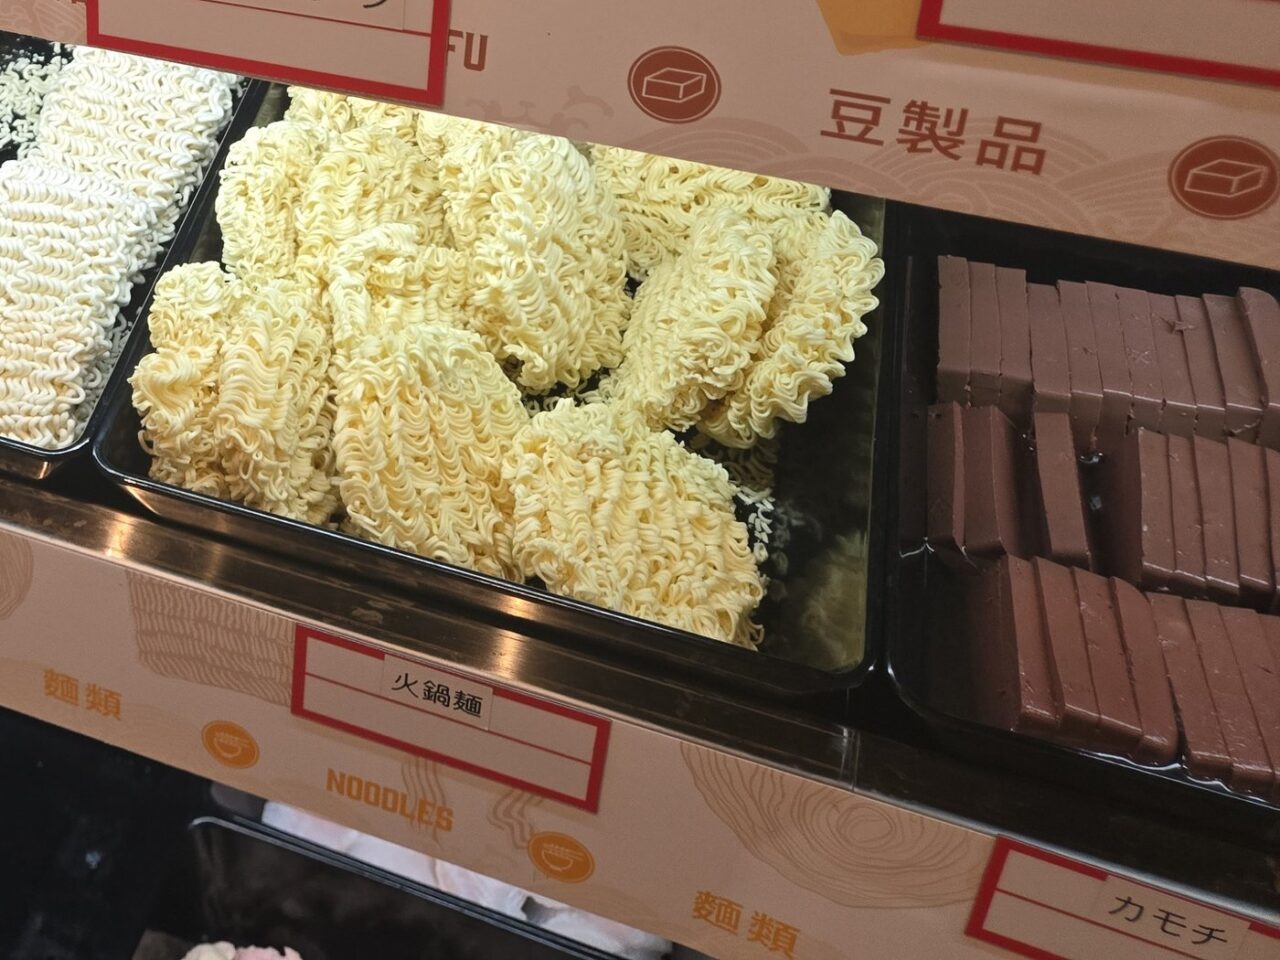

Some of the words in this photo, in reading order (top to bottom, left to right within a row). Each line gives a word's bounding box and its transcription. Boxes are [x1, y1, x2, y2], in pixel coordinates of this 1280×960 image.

[820, 88, 1047, 176] 豆製品
[391, 672, 483, 718] 火鍋麺
[326, 768, 454, 833] NOODLES
[1108, 896, 1228, 945] カモチ
